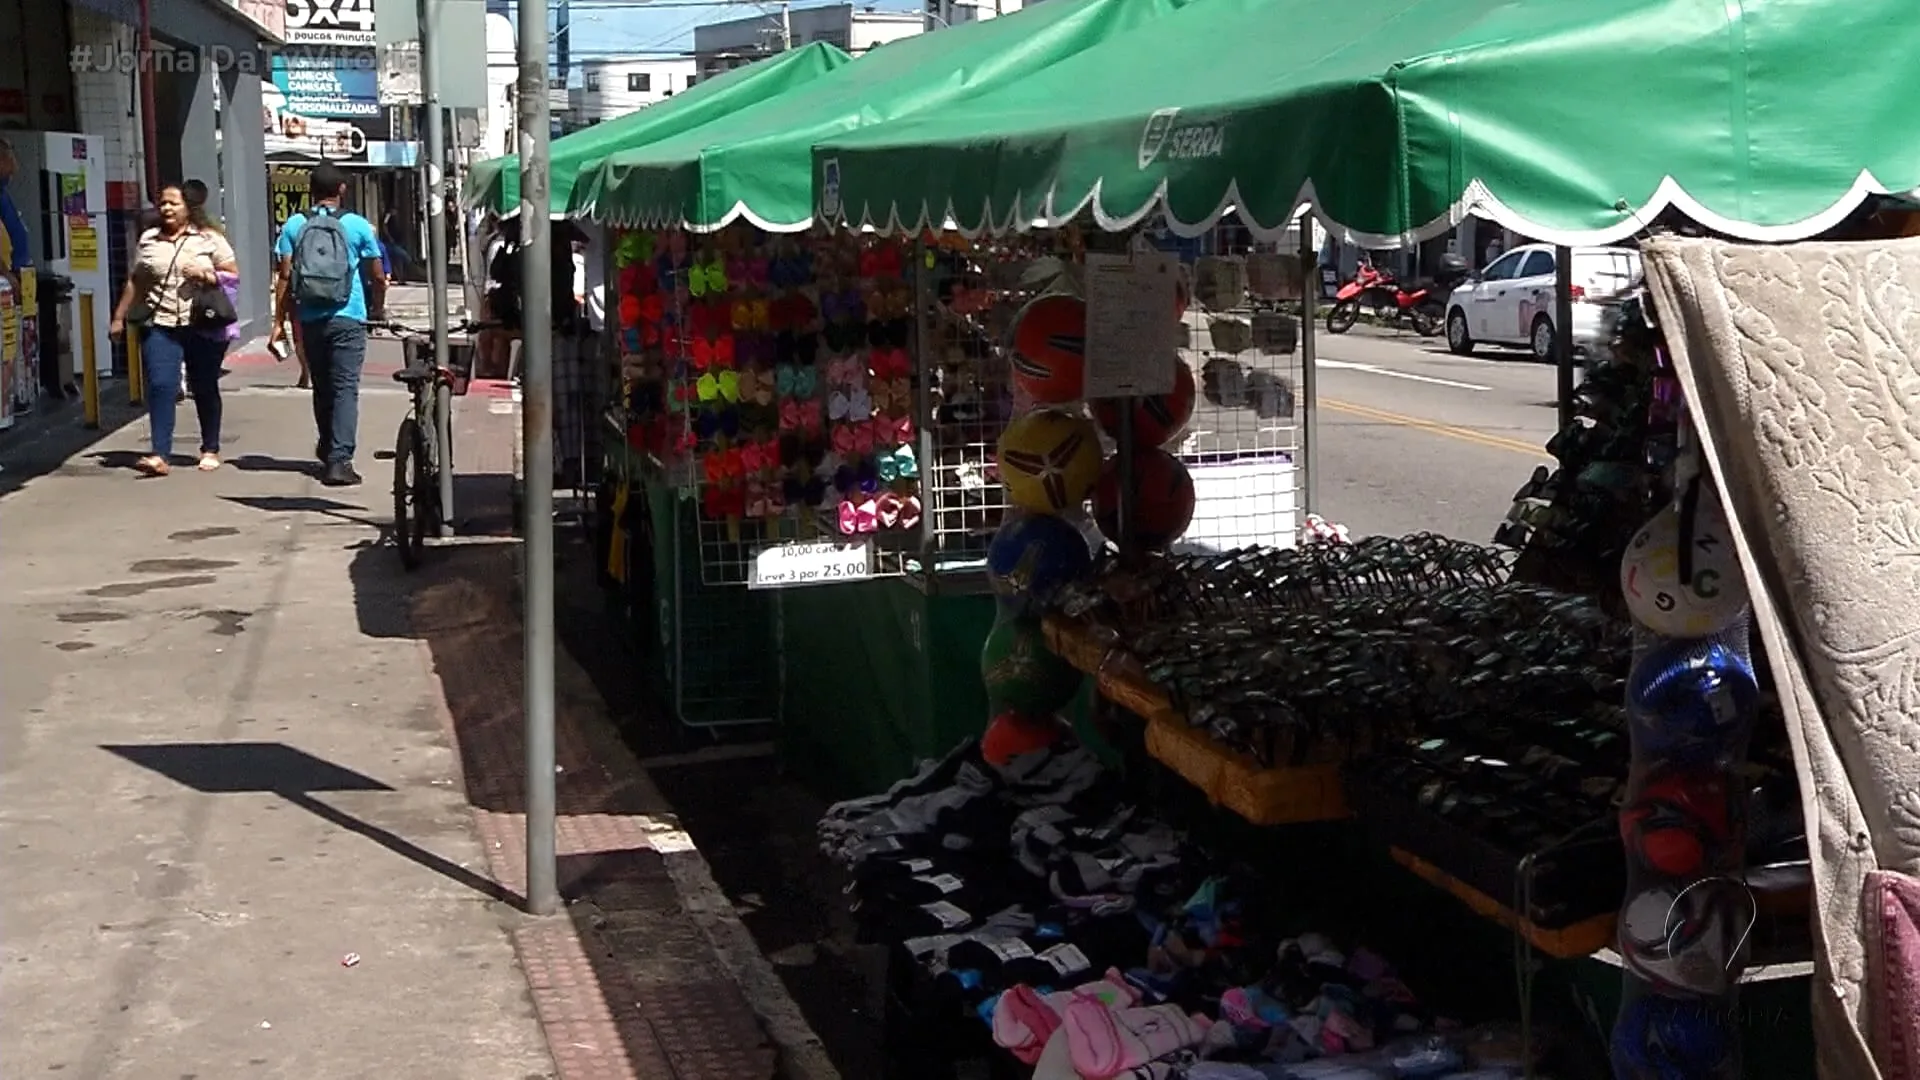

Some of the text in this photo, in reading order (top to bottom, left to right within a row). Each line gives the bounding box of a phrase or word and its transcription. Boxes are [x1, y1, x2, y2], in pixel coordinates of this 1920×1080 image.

[294, 33, 332, 42] poucos
[1168, 126, 1225, 159] SERRA
[789, 570, 796, 580] 3
[799, 571, 819, 584] por
